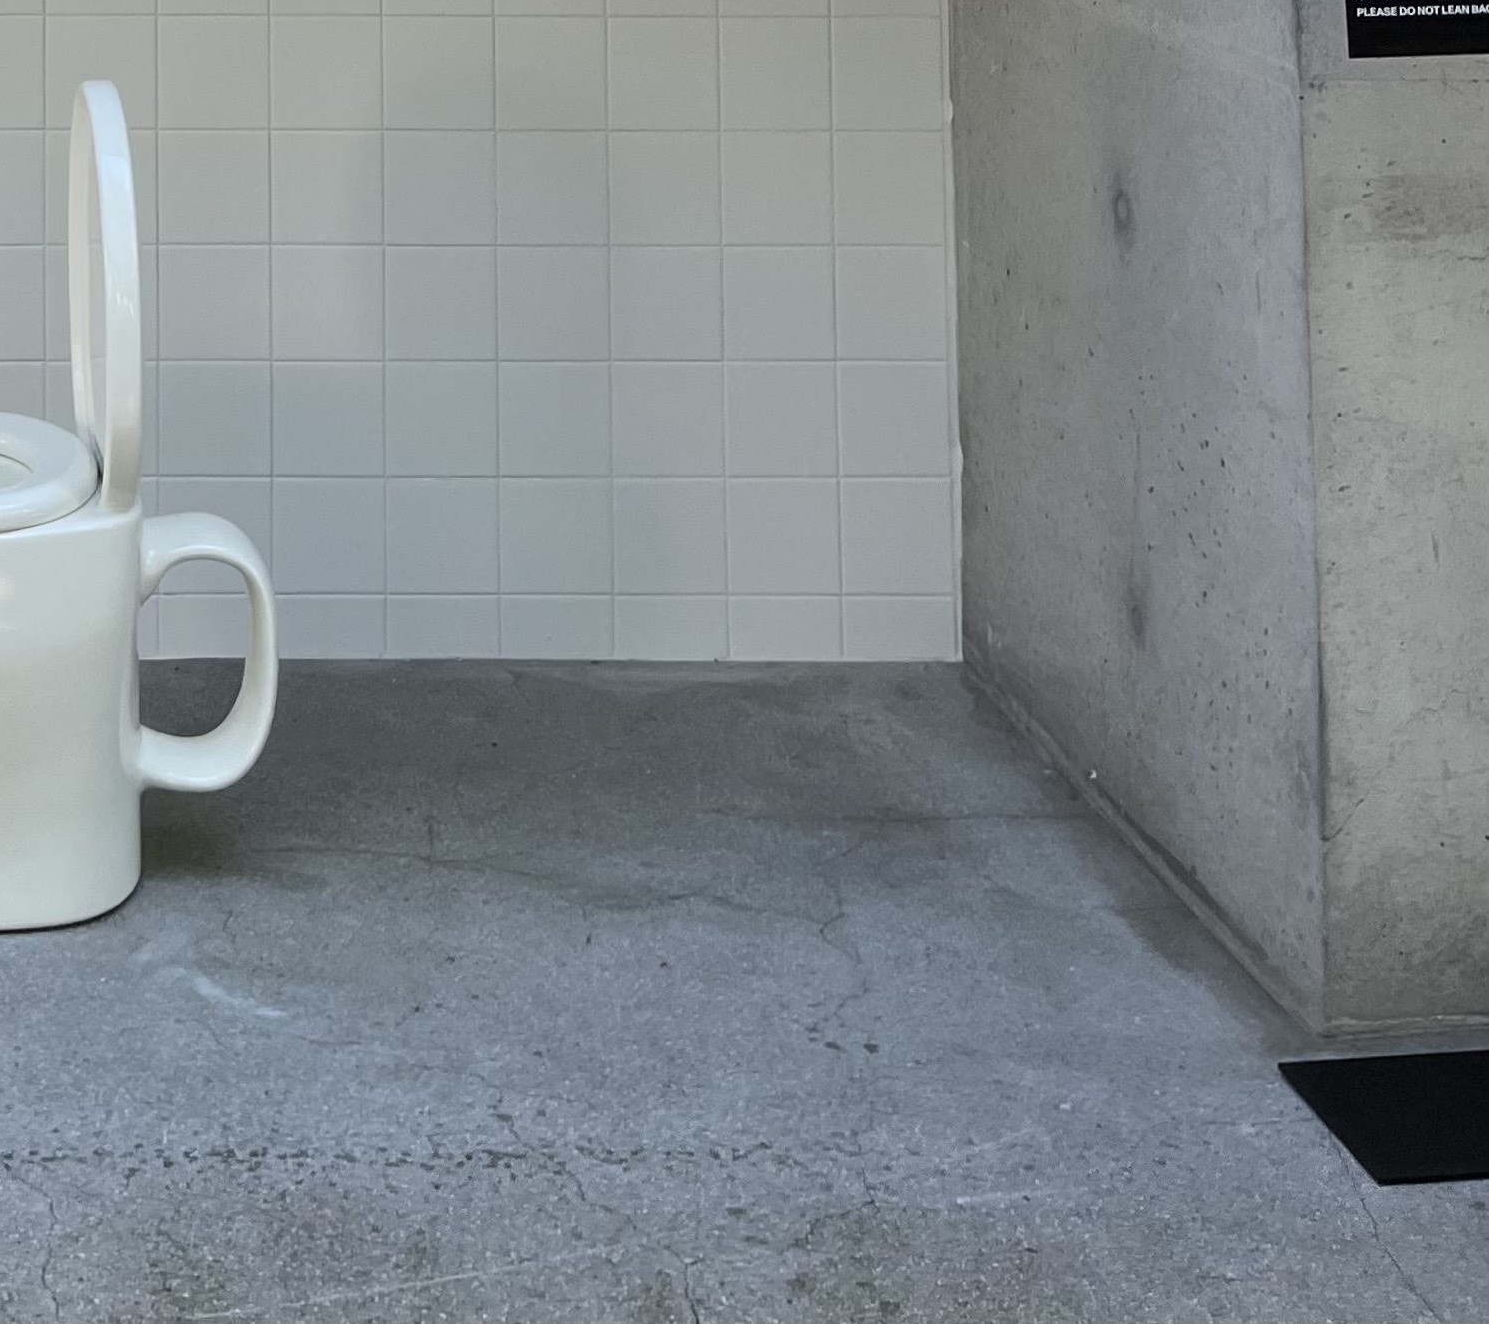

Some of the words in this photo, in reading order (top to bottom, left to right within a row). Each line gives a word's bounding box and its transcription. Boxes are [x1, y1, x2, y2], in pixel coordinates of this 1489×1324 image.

[1357, 6, 1398, 17] PLEASE
[1399, 6, 1416, 16] DO
[1417, 5, 1440, 15] NOT
[1441, 4, 1470, 15] LEAN
